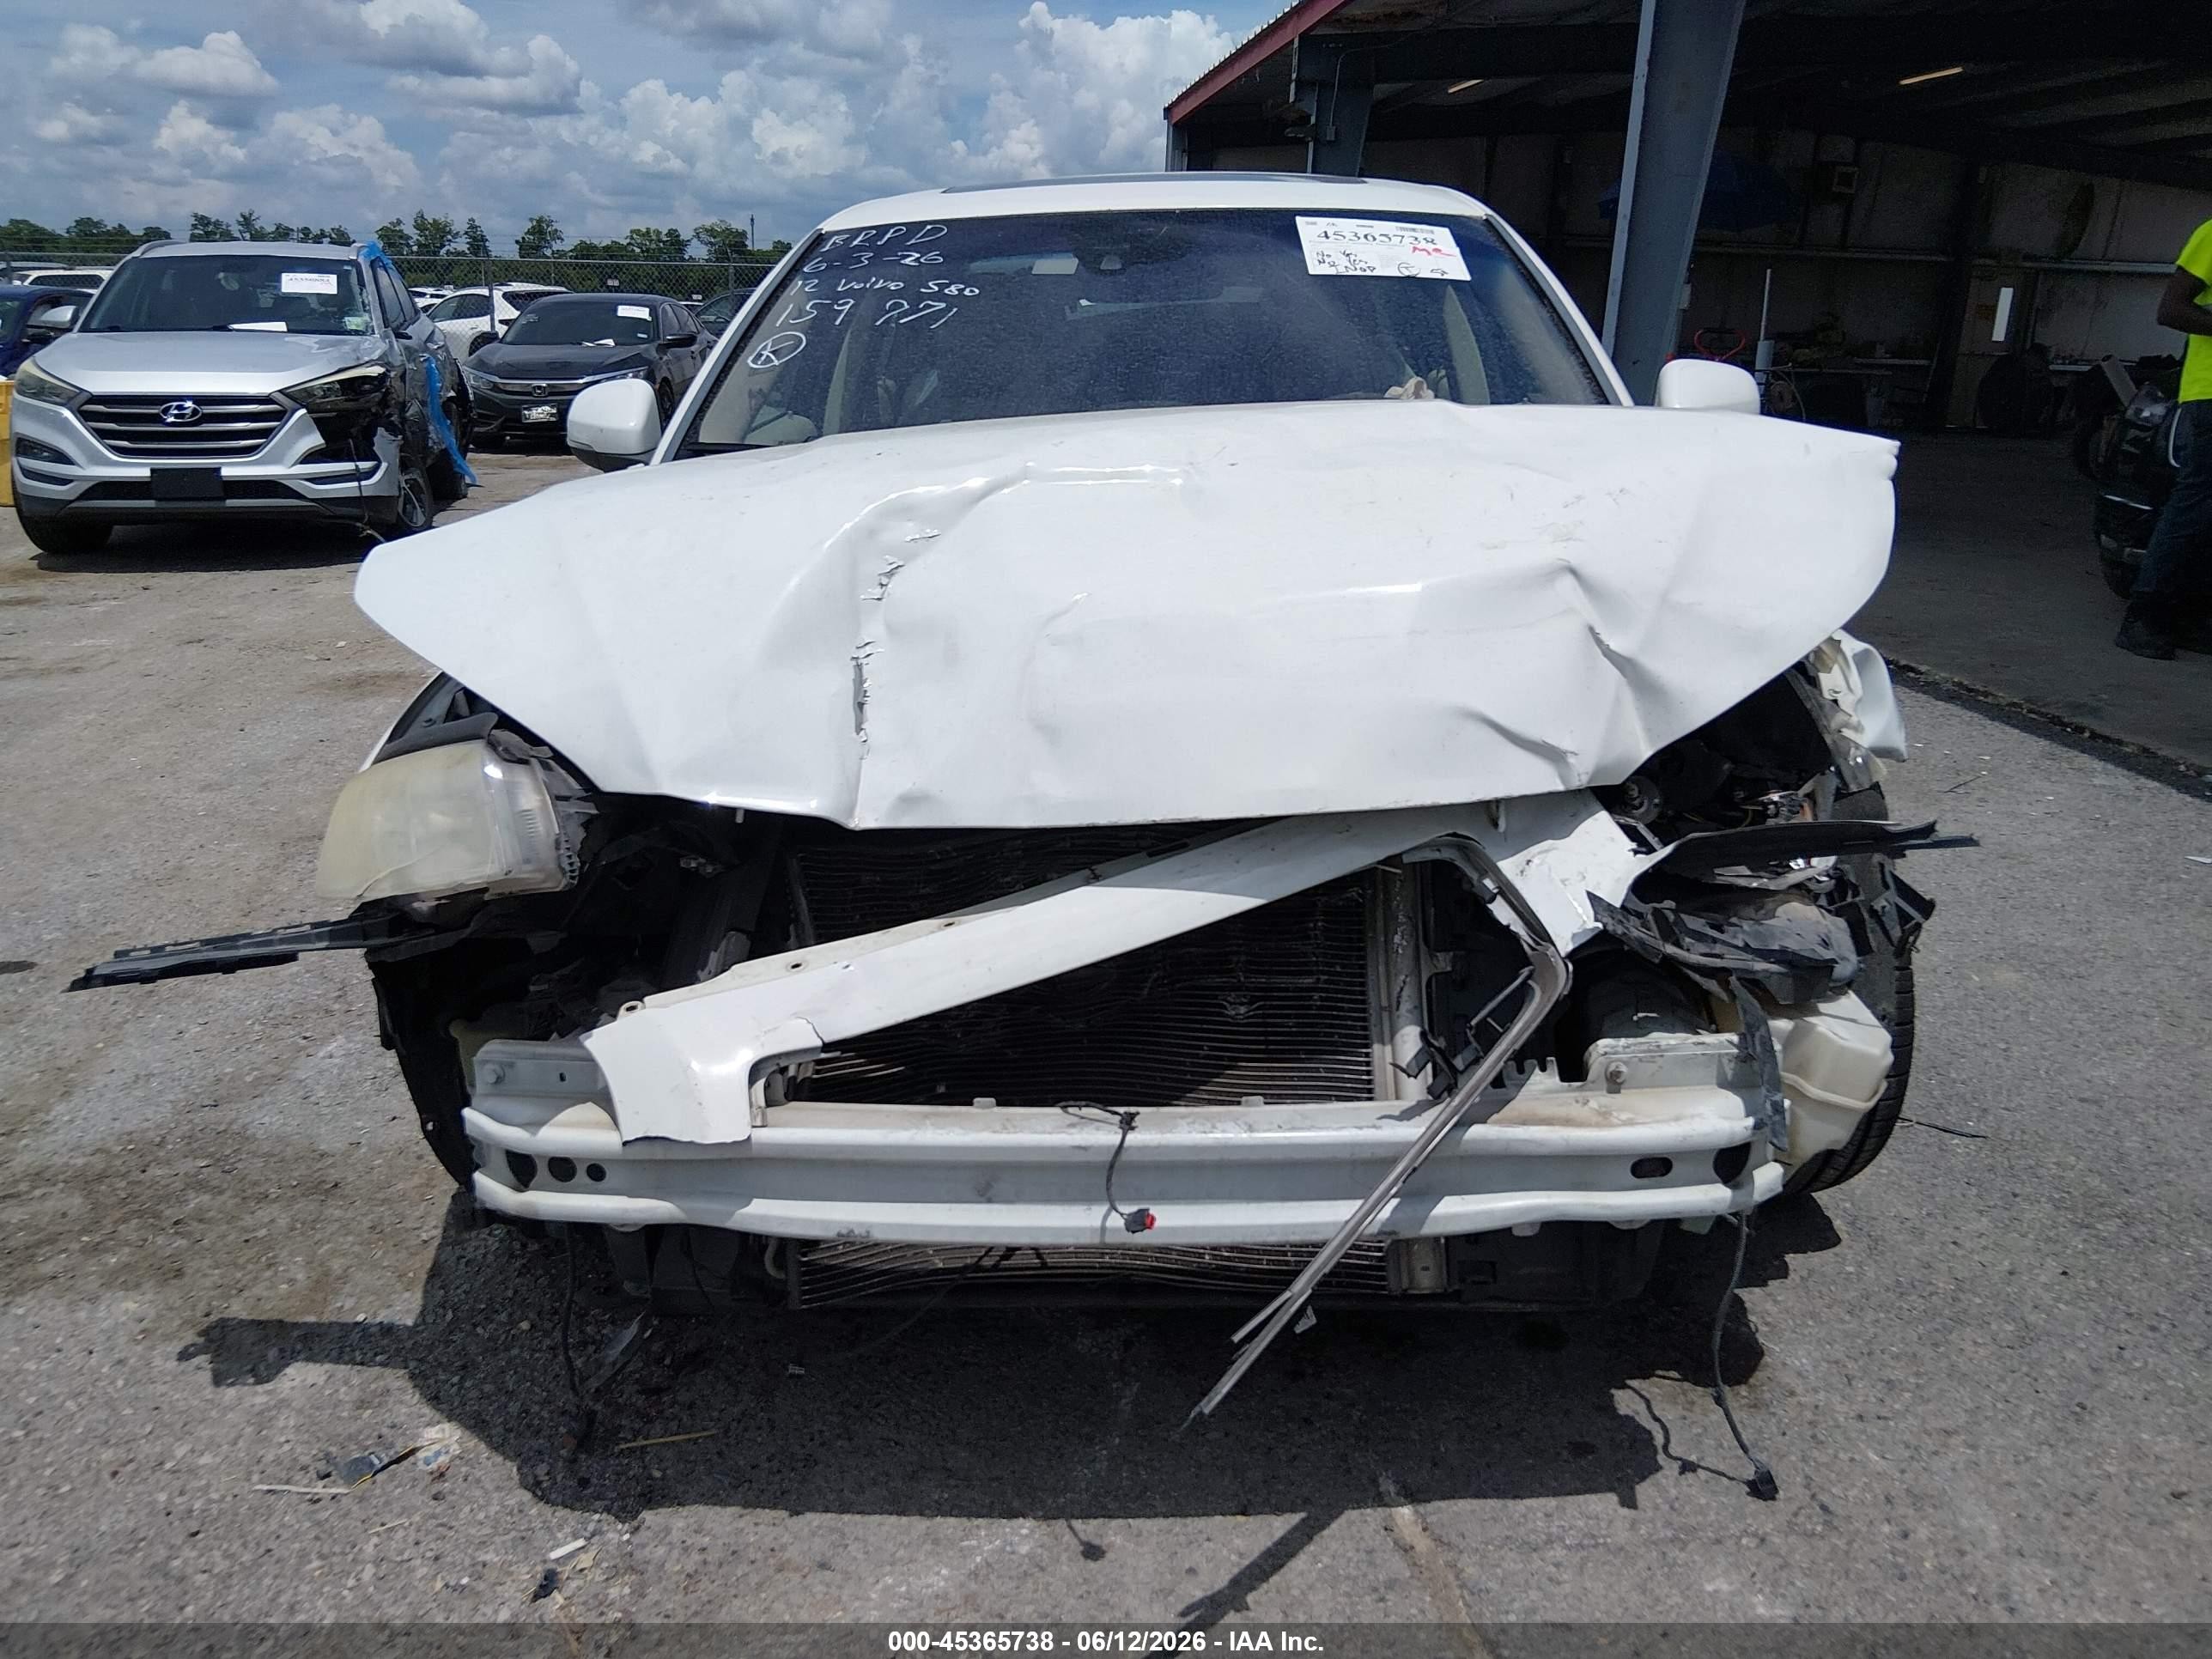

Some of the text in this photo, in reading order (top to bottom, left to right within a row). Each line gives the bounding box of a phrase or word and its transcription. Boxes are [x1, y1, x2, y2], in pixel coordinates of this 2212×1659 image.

[821, 225, 948, 252] BRPD
[803, 252, 944, 273] 6-3-26
[776, 299, 854, 326] 159
